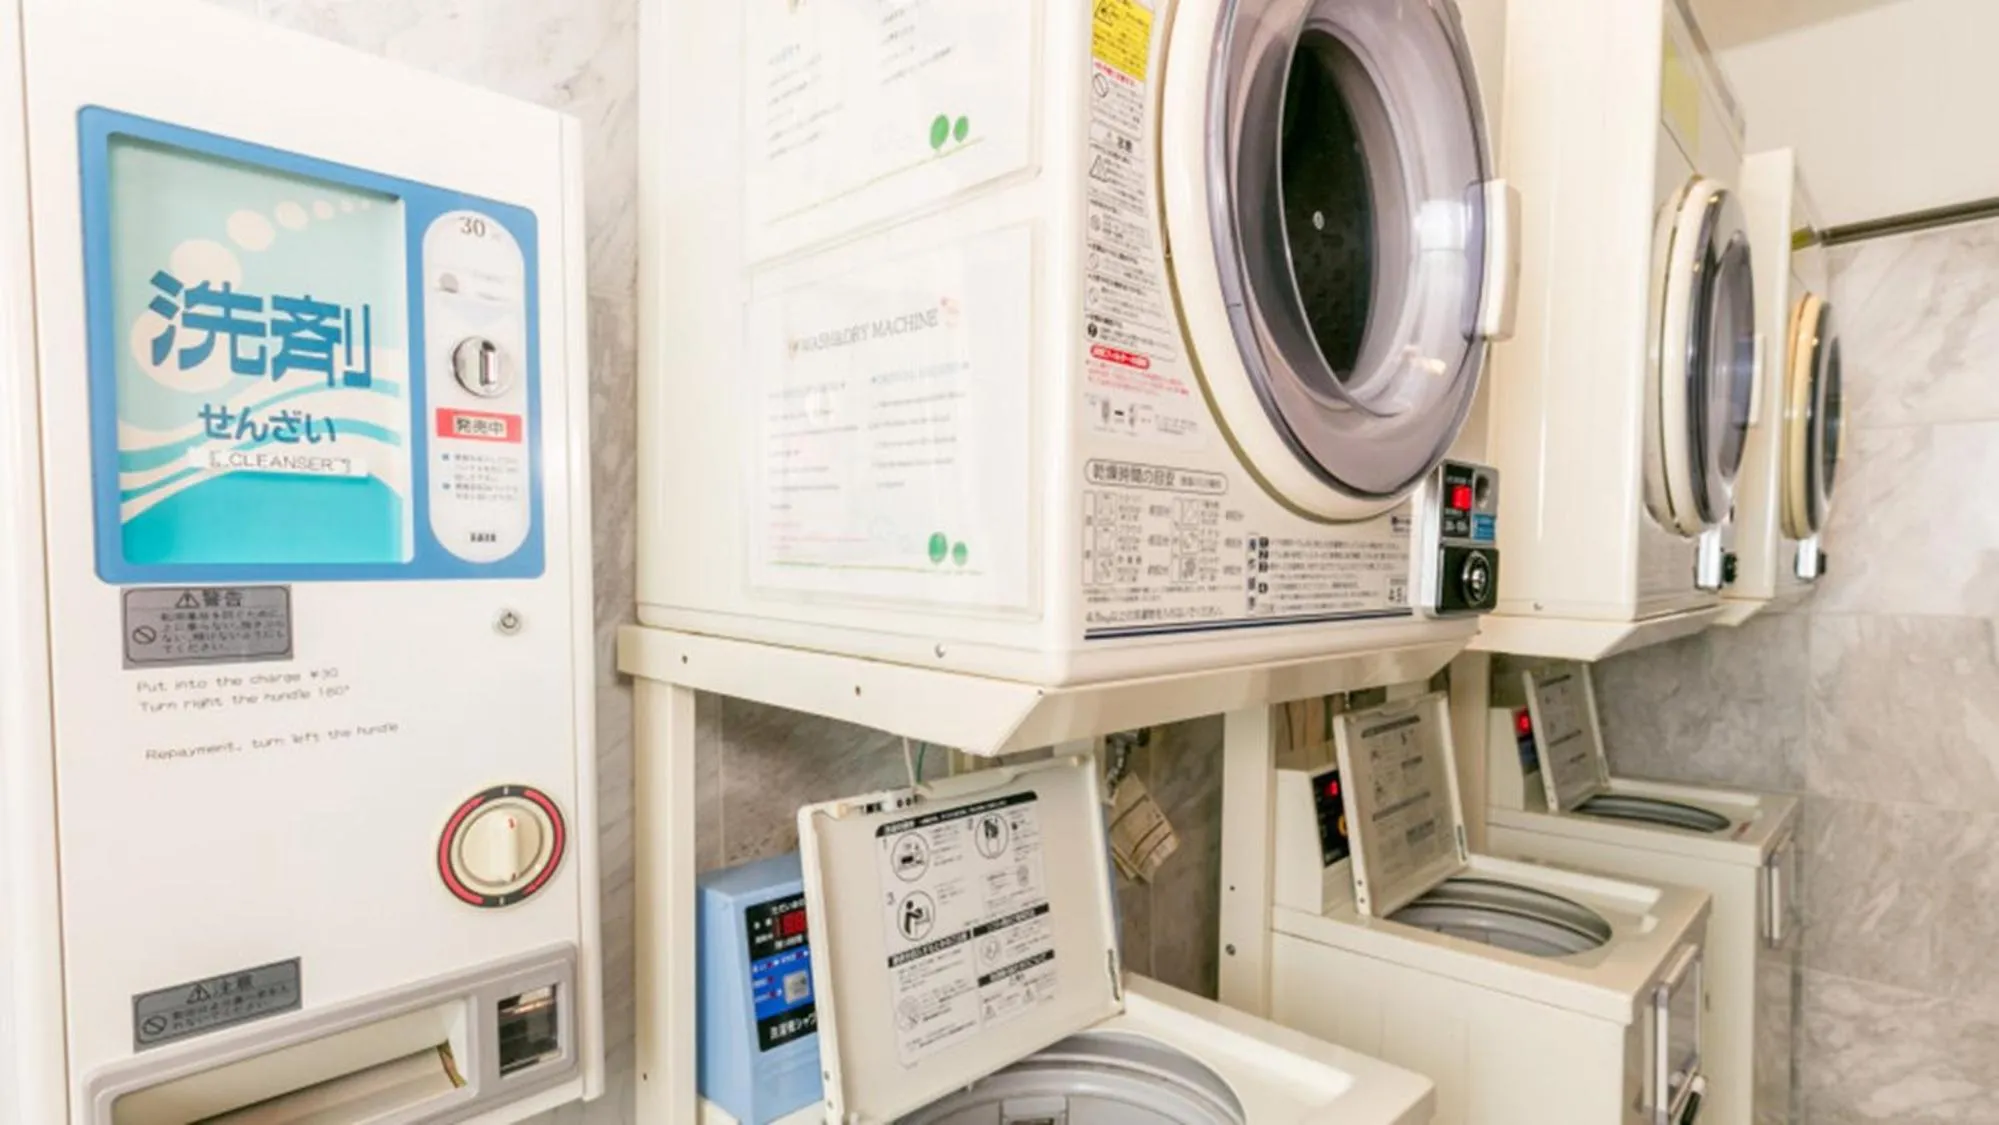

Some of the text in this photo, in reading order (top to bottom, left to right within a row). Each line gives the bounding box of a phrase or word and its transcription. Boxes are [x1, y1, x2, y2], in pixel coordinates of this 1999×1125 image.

[458, 216, 486, 238] 30
[148, 269, 372, 388] 洗剤
[872, 307, 939, 339] MACHINE
[198, 402, 337, 444] せんざい
[456, 416, 504, 436] 発売中
[228, 452, 334, 473] CLEANSER
[1092, 463, 1175, 487] 乾燥時間の目安
[202, 588, 243, 608] 警告
[137, 681, 165, 693] Put
[175, 679, 207, 691] into
[216, 674, 243, 687] the
[250, 670, 302, 686] charge
[141, 700, 178, 713] Turn
[183, 696, 224, 711] right
[232, 693, 259, 705] the
[251, 736, 286, 750] turn
[290, 732, 321, 745] left
[328, 729, 353, 741] the
